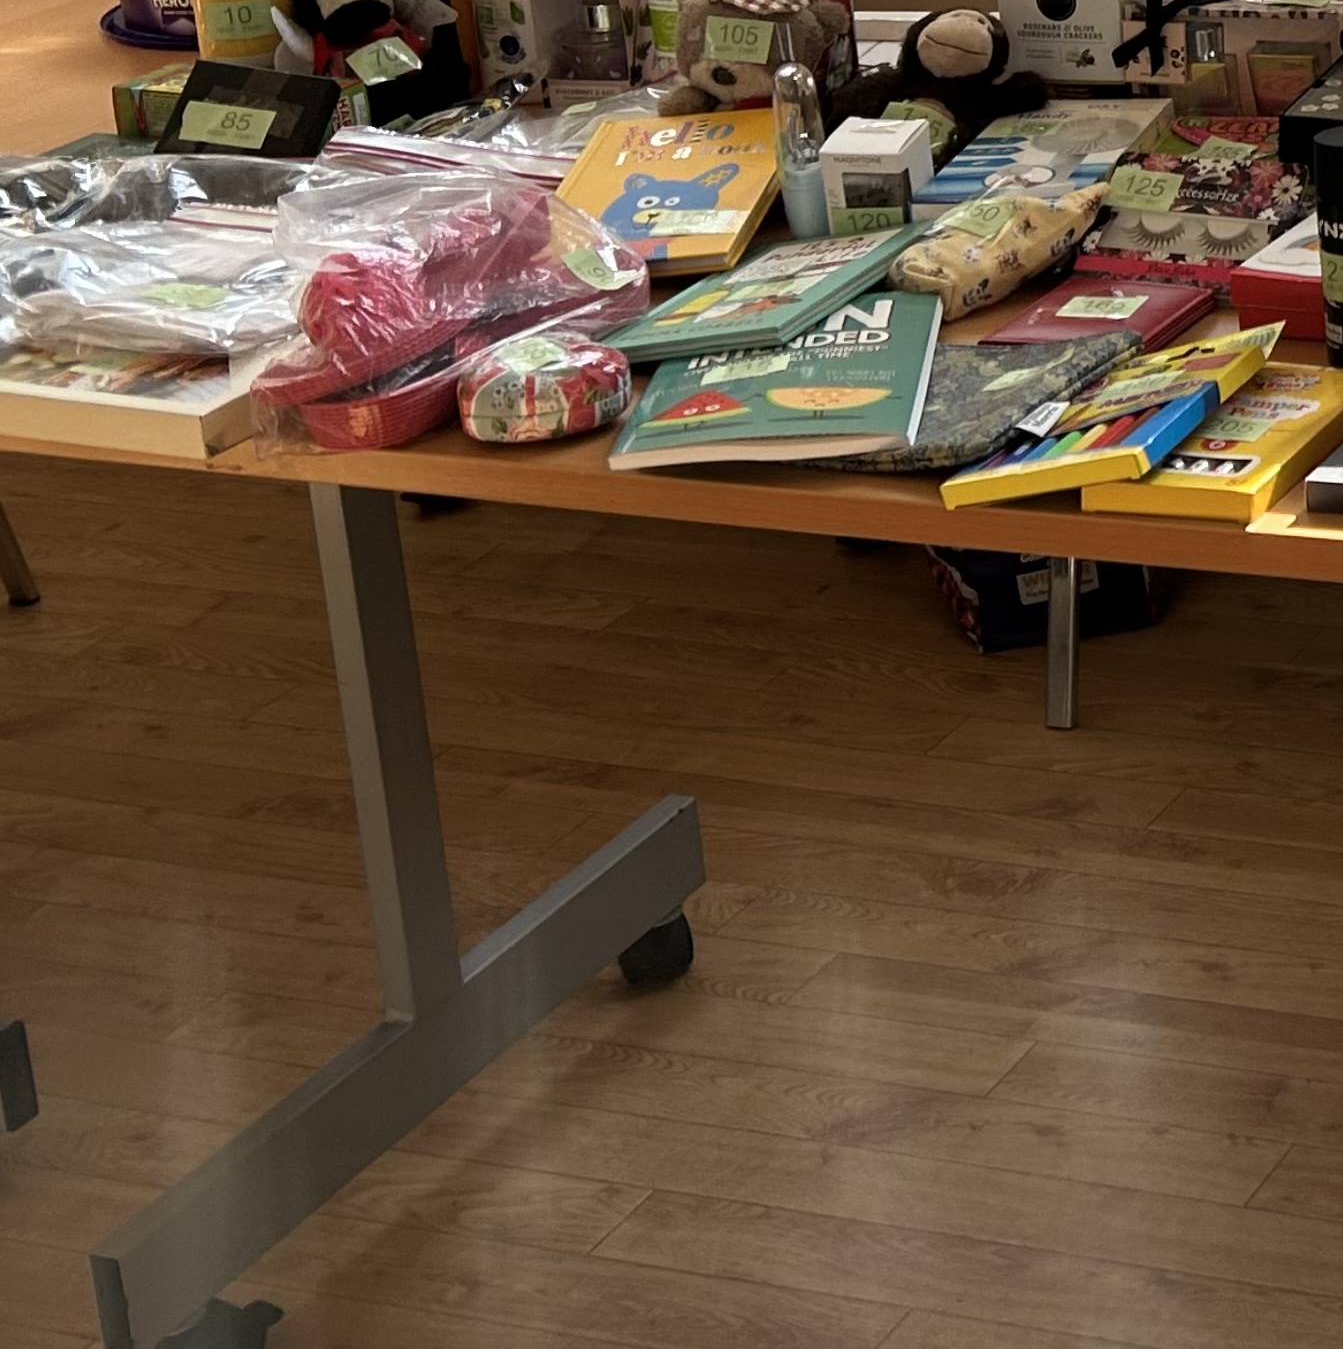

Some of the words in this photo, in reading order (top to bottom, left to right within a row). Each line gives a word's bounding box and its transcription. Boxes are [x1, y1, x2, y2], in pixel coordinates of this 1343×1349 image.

[224, 5, 252, 26] 10
[719, 24, 759, 46] 105
[220, 111, 254, 132] 85
[1126, 174, 1167, 197] 125
[1177, 186, 1240, 202] ccessorize
[847, 212, 890, 231] 120
[970, 204, 1000, 222] 50
[1211, 419, 1255, 433] 205
